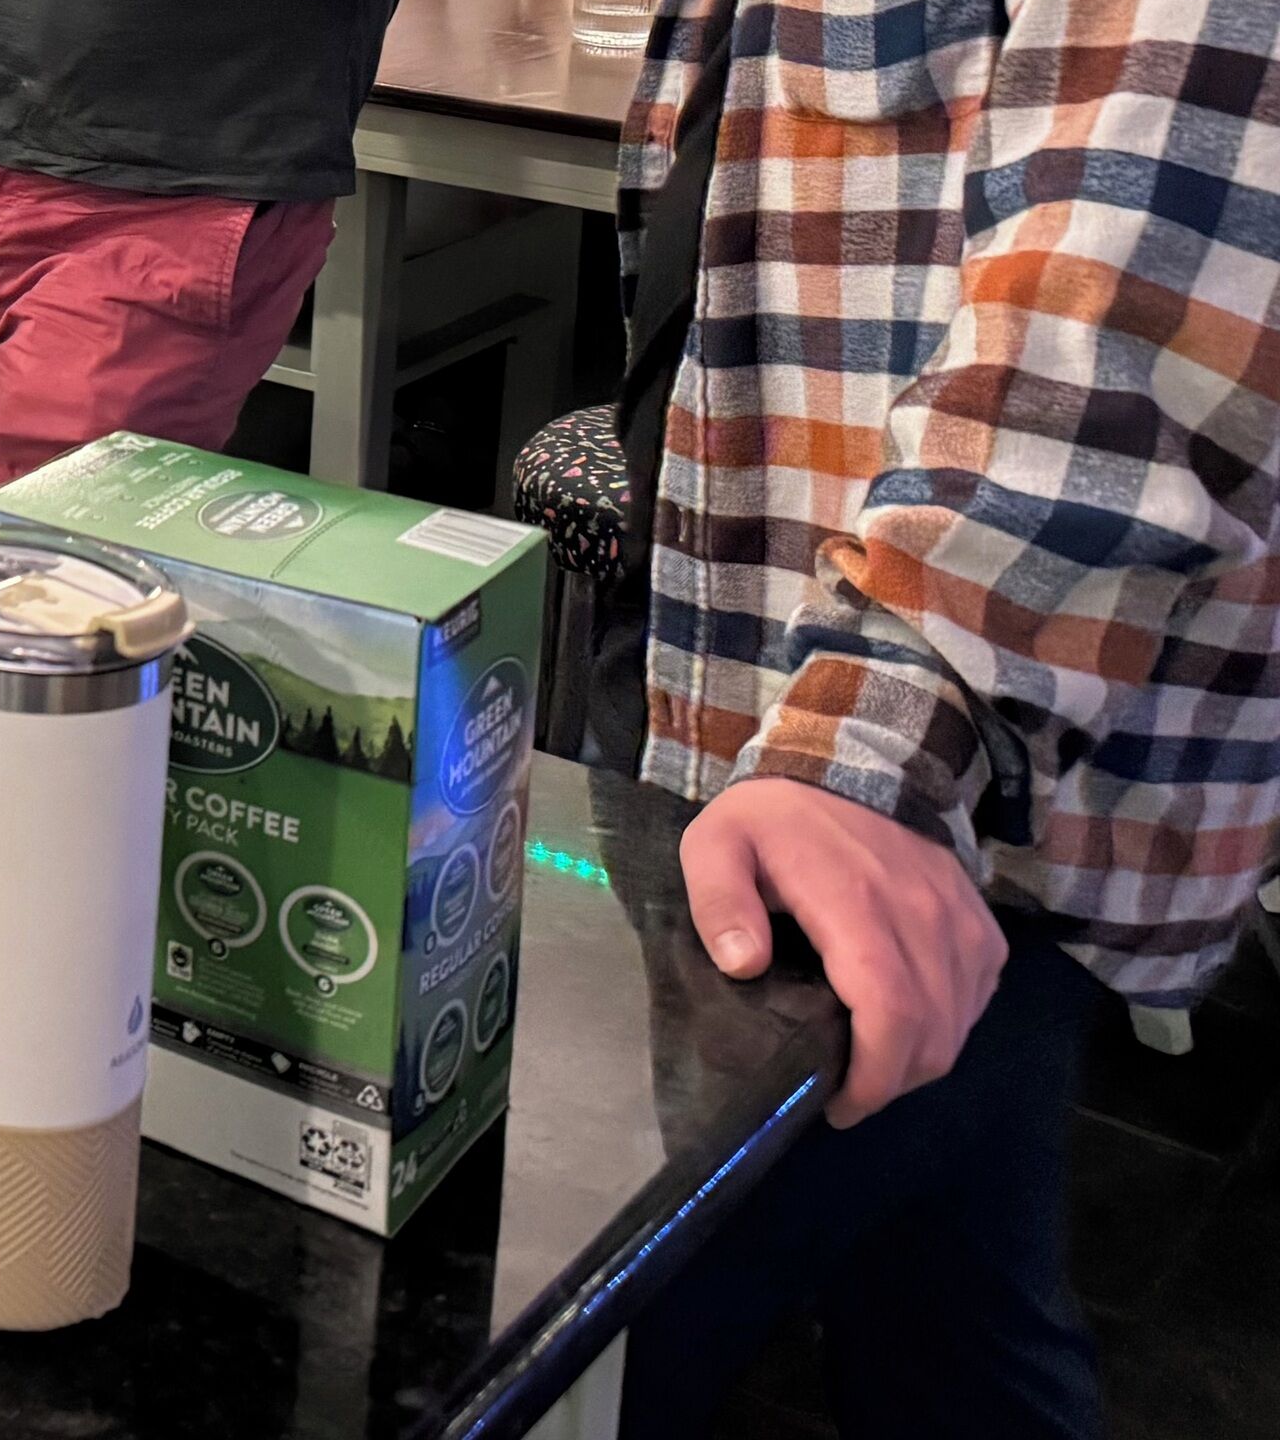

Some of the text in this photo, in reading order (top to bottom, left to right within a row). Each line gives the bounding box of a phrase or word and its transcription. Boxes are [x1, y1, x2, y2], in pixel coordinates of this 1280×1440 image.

[464, 686, 513, 746] GREEN
[449, 707, 523, 790] MOUNTAIN
[185, 786, 301, 844] COFFEE
[186, 814, 239, 847] PACK
[420, 929, 482, 995] REGULAR
[392, 1150, 417, 1198] 24
